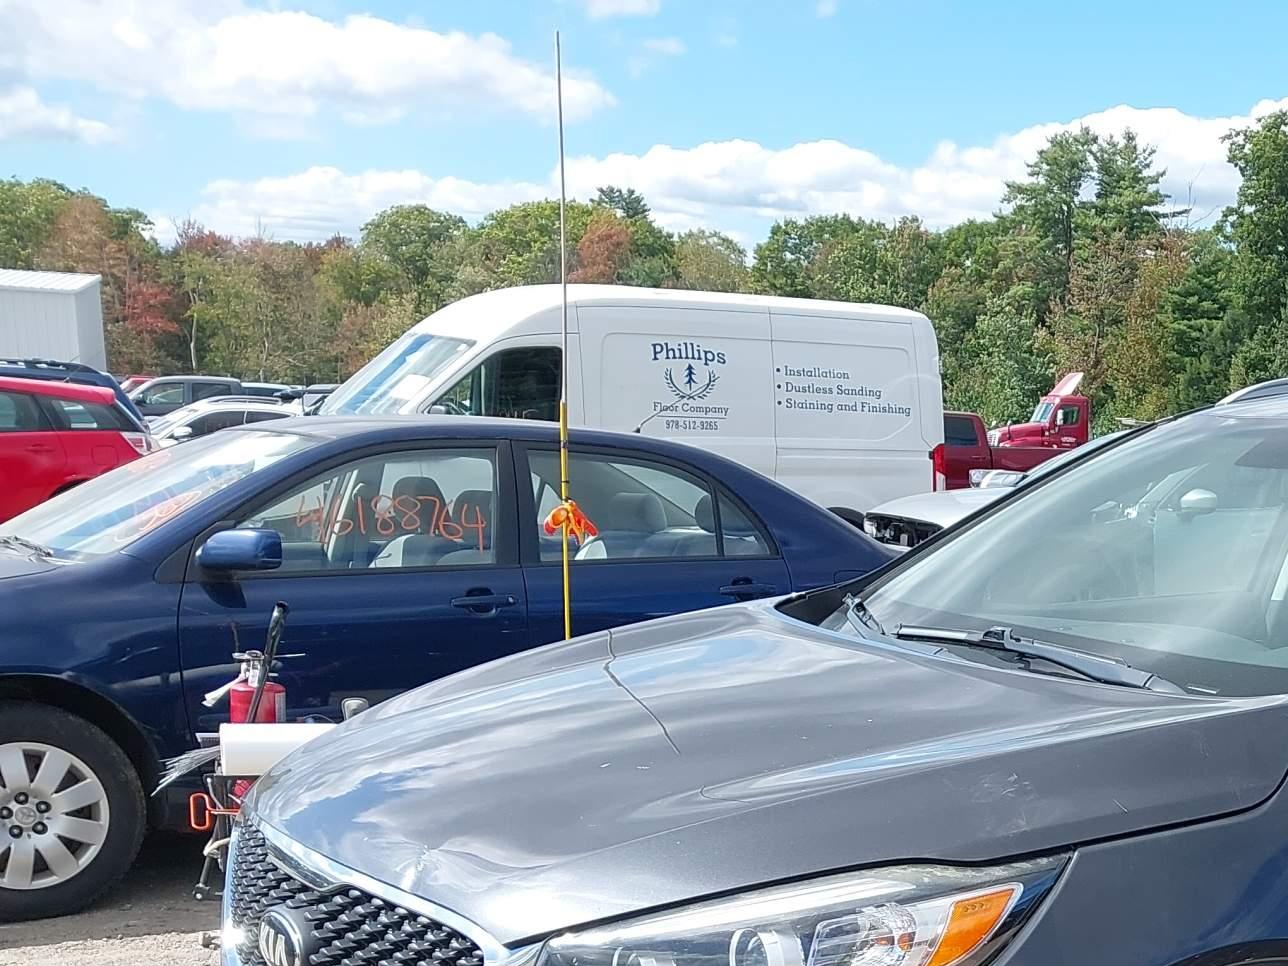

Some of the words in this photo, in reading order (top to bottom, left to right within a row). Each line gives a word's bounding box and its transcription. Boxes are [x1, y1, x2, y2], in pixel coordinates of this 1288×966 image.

[650, 341, 727, 367] Phillips
[783, 365, 851, 381] Installation
[784, 382, 835, 396] Dustless
[836, 384, 883, 400] Sanding
[652, 401, 679, 413] Floor
[681, 402, 730, 417] Company
[784, 398, 834, 414] Staining
[836, 401, 858, 412] and
[860, 402, 911, 417] Finishing
[665, 419, 719, 431] 978-512-9265
[296, 495, 486, 554] 46188764
